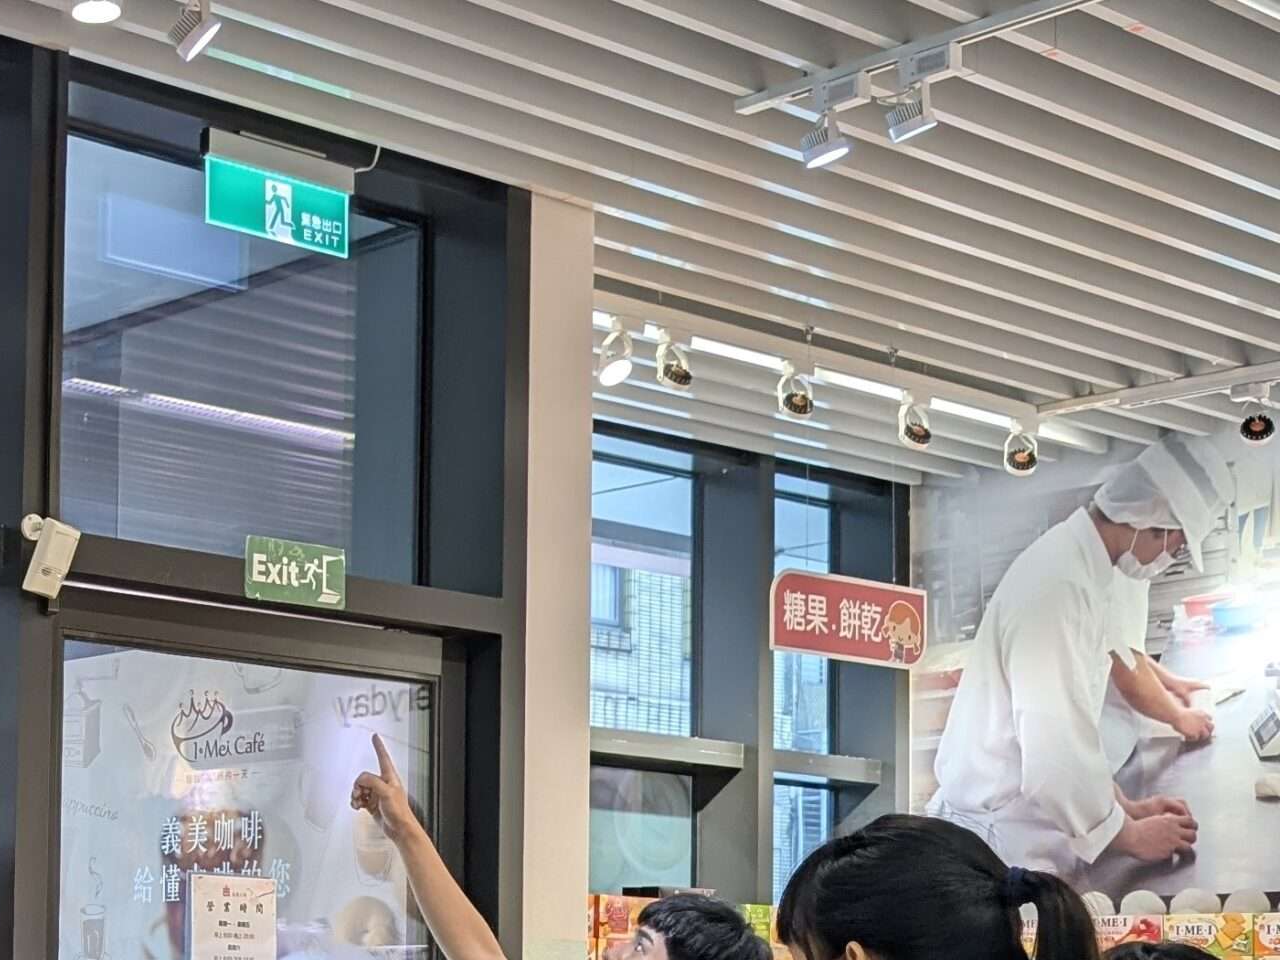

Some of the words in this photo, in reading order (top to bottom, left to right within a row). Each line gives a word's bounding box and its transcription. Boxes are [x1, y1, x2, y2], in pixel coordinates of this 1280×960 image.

[303, 228, 340, 248] EXIT
[252, 552, 300, 588] Exit
[234, 732, 265, 755] Café
[160, 810, 263, 855] 義美咖啡
[133, 858, 291, 904] 給懂您
